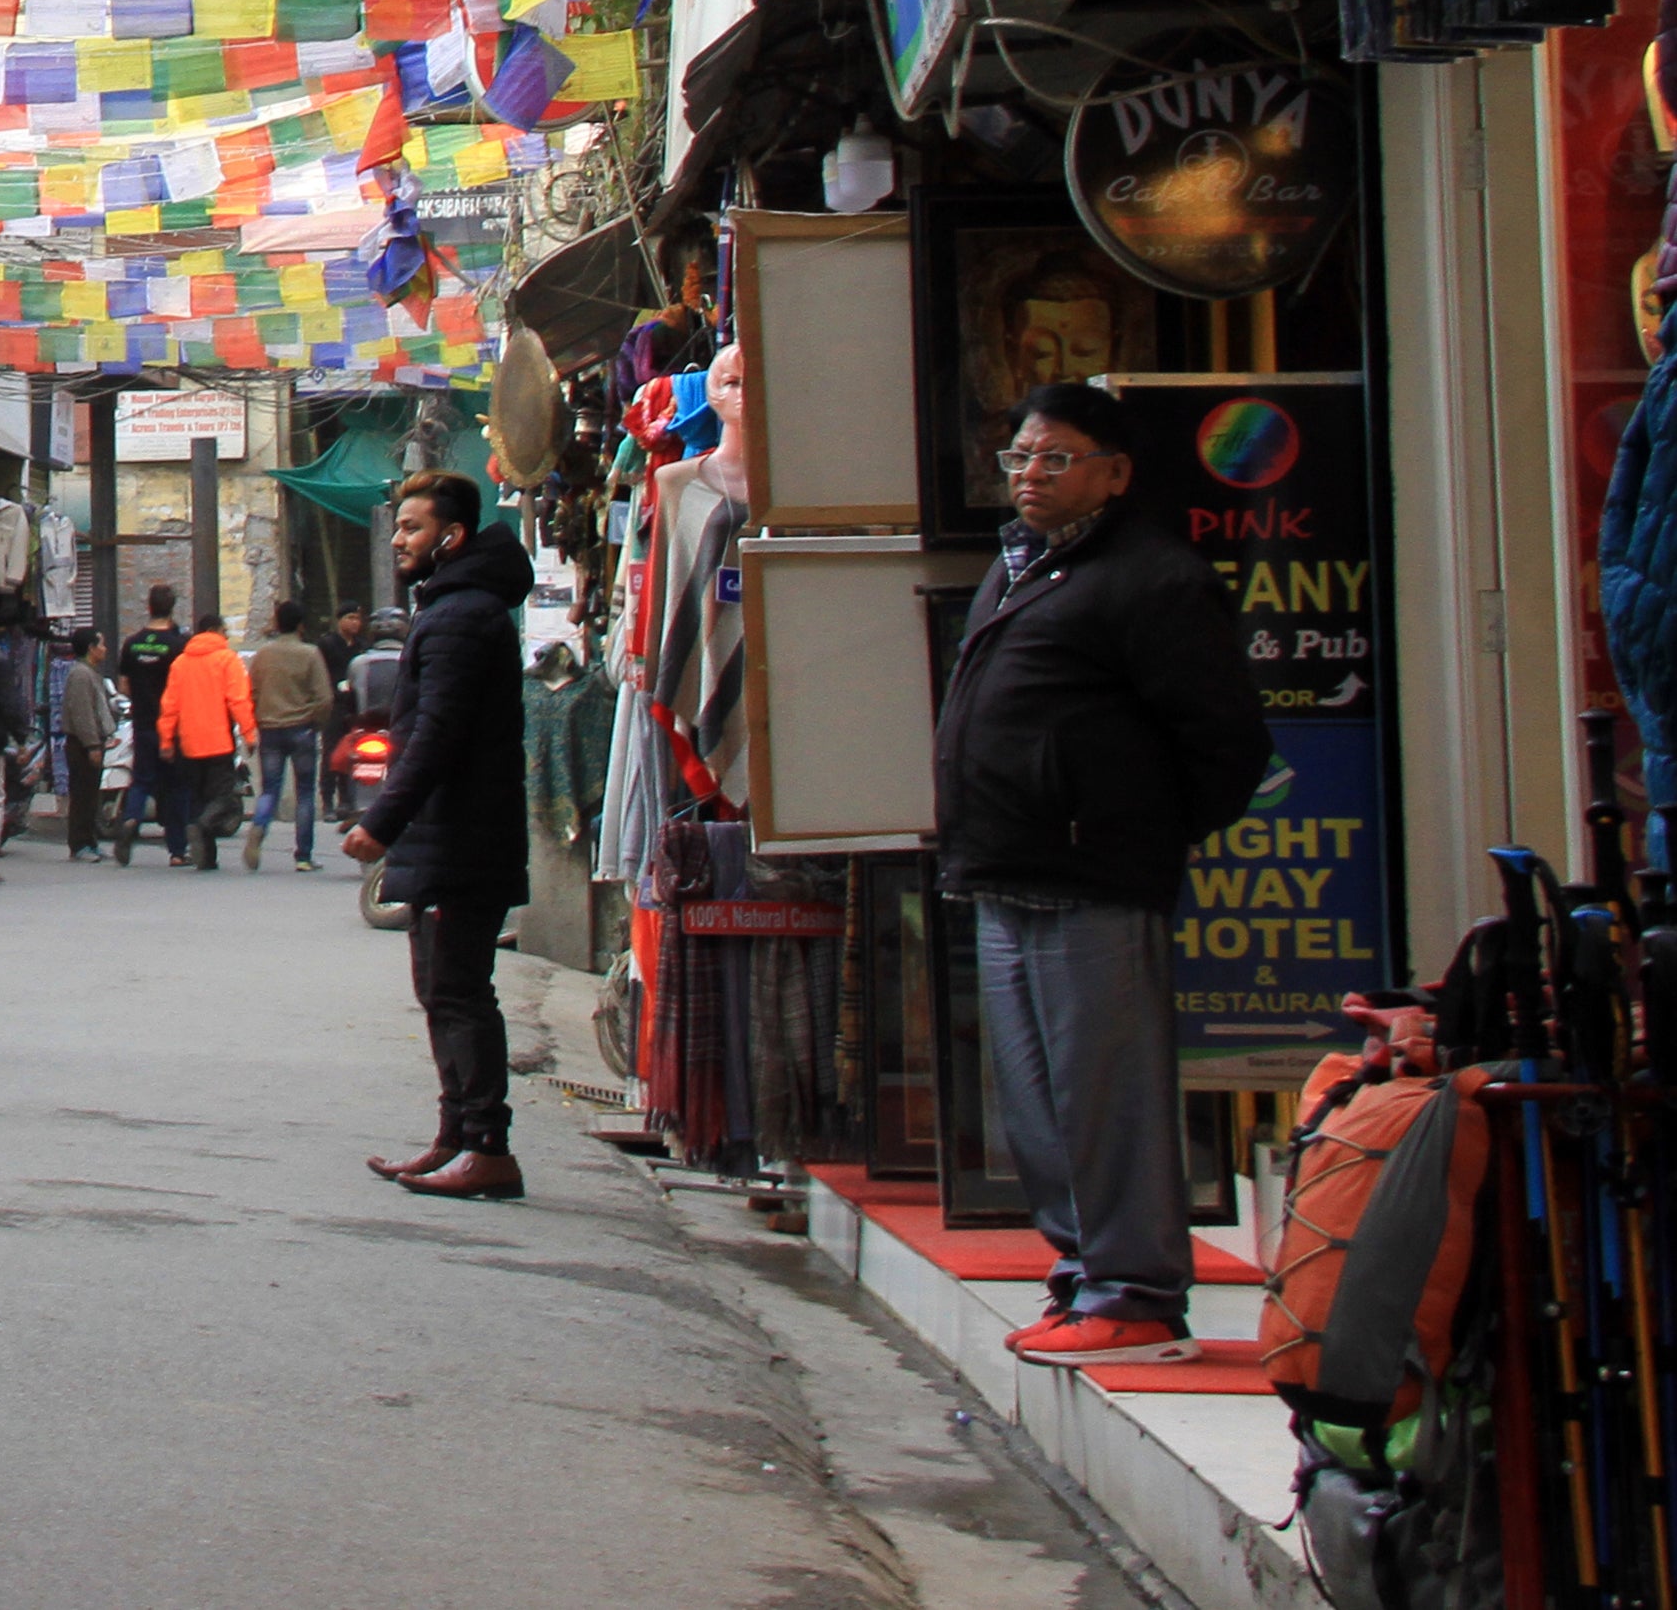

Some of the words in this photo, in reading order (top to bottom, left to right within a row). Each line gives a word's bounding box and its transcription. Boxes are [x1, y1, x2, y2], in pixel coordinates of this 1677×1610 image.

[1108, 58, 1311, 156] DUNYA
[1246, 174, 1323, 202] Bar
[1188, 496, 1313, 543] PINK
[1248, 629, 1280, 660] &
[1292, 628, 1369, 660] Pub
[1260, 690, 1317, 708] OOR
[1188, 866, 1334, 909] WAY
[688, 905, 728, 928] 100%
[733, 905, 787, 928] Natural
[1173, 917, 1375, 960] HOTEL
[1254, 964, 1279, 987] &
